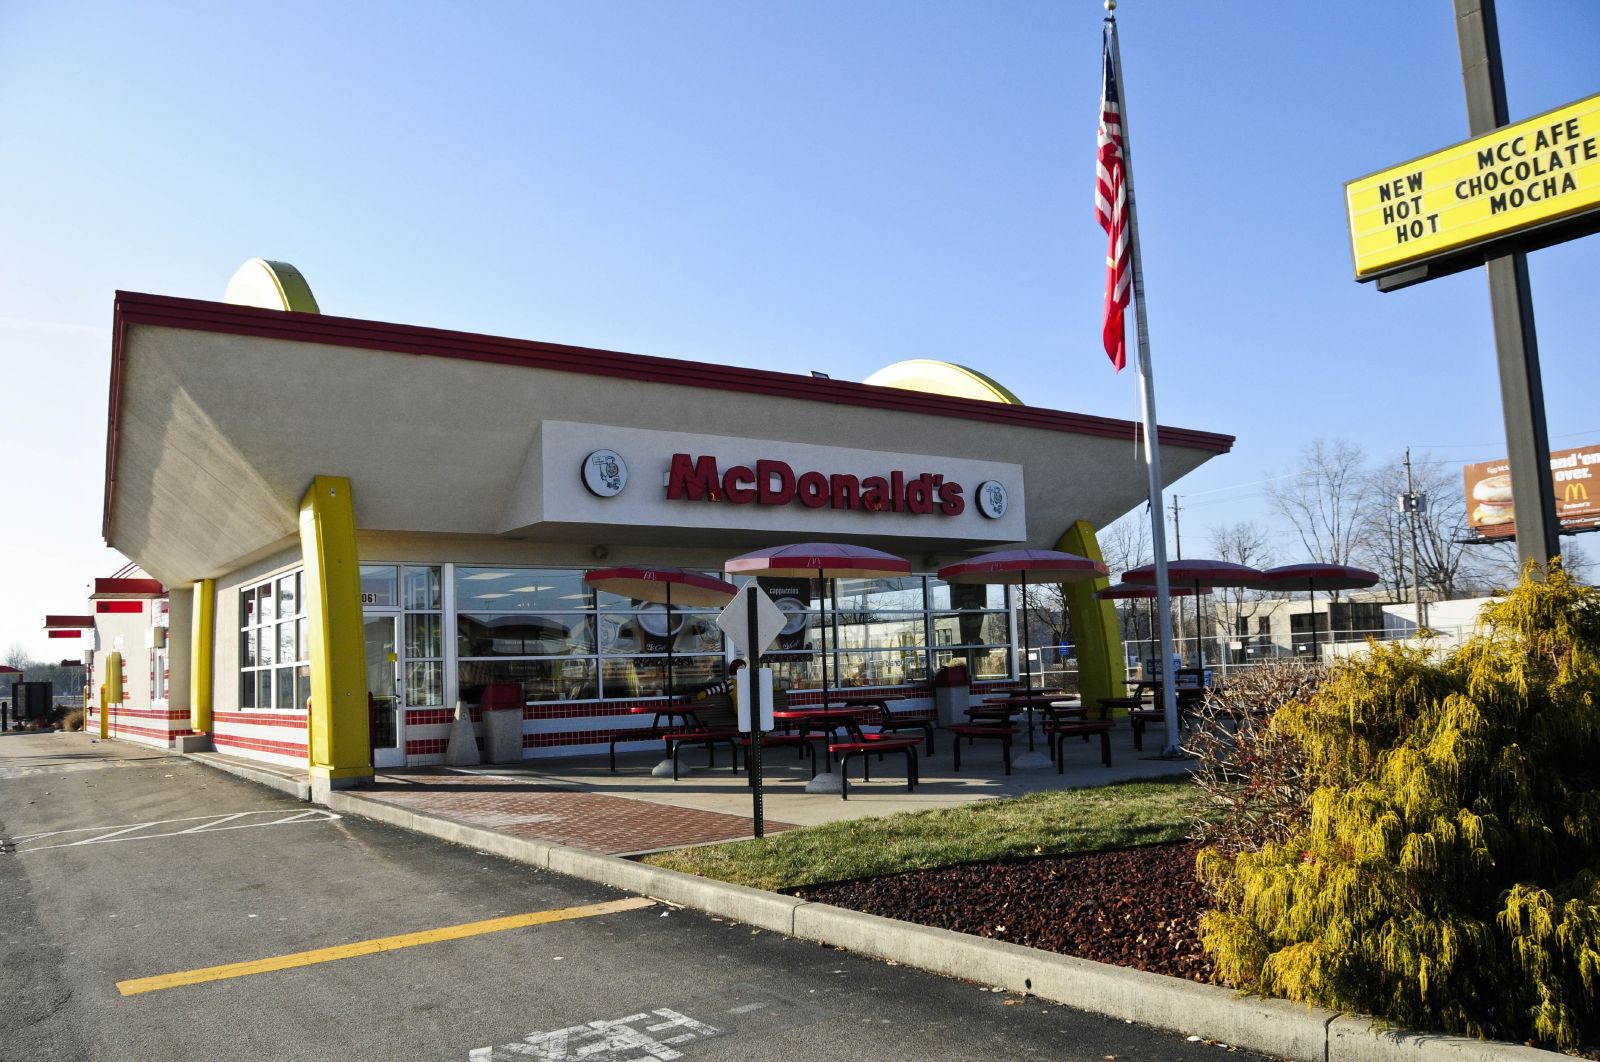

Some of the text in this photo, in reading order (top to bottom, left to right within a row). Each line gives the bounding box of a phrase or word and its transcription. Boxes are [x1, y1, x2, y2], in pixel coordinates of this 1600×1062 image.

[1379, 171, 1423, 202] NEW
[1383, 137, 1598, 225] HOT CHOCOLATE
[1396, 172, 1577, 243] HOT MOCHA
[666, 453, 965, 516] McDonald's
[1555, 468, 1592, 481] over.
